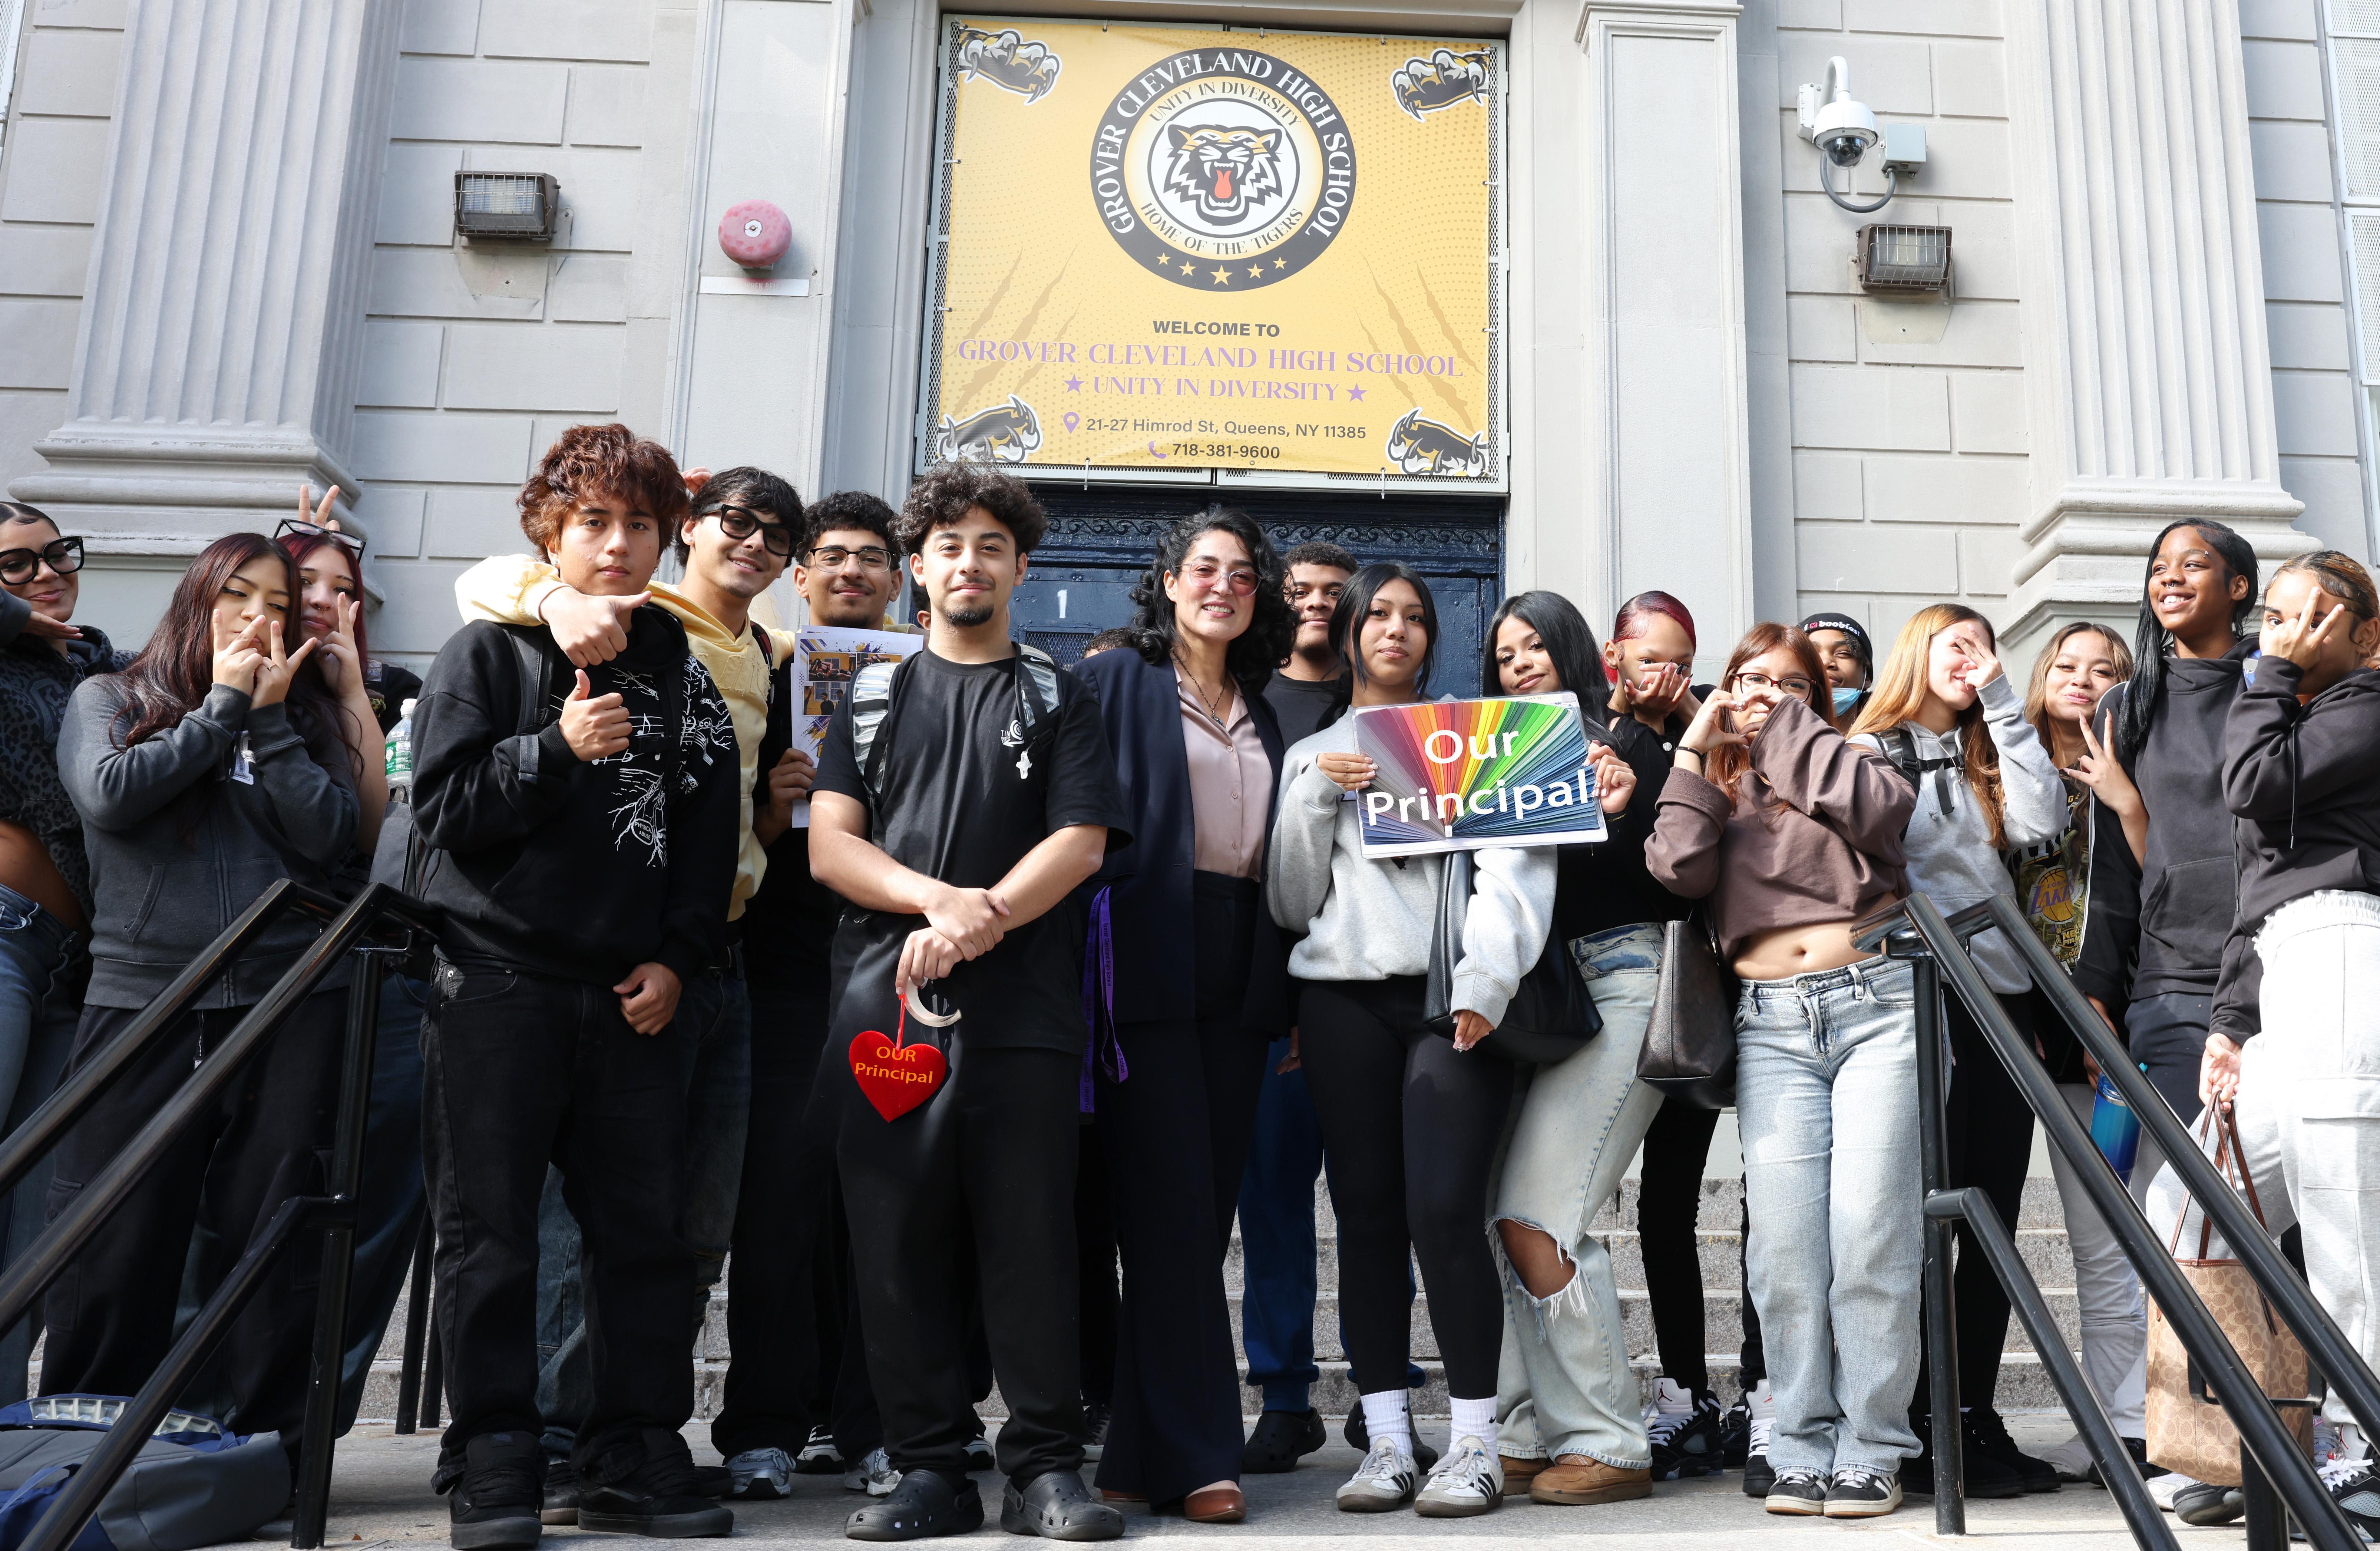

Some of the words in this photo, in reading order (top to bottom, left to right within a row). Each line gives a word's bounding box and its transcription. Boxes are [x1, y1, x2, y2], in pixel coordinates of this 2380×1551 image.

[1117, 52, 1272, 118] CLEVELAND
[1276, 70, 1337, 128] HIGH
[1149, 87, 1192, 121] UNITY
[1198, 82, 1216, 96] IN
[1222, 81, 1302, 127] DIVERSITY
[1096, 124, 1135, 234] GROVER
[1305, 132, 1351, 238] SCHOOL
[1141, 202, 1182, 242] HOME
[1184, 236, 1207, 252] OF
[1213, 241, 1247, 255] THE
[1250, 208, 1304, 249] TIGERS
[1153, 320, 1250, 336] WELCOME
[1255, 324, 1280, 337] TO
[958, 339, 1076, 363] GROVER
[1088, 343, 1257, 368] CLEVELAND
[1268, 349, 1335, 371] HIGH
[1346, 352, 1464, 377] SCHOOL
[1094, 376, 1167, 395] UNITY
[1176, 378, 1200, 397] IN
[1209, 379, 1339, 402] DIVERSITY
[1086, 418, 1128, 431] 21-27
[1134, 419, 1193, 433] Himrod
[1198, 420, 1219, 435] St,
[1224, 421, 1290, 437] Queens,
[1296, 424, 1319, 437] NY
[1323, 425, 1366, 439] 11385
[1172, 443, 1280, 459] 718-381-9600
[1057, 589, 1068, 618] 1
[1819, 620, 1860, 636] boobies!
[1424, 729, 1519, 764] Our
[1366, 769, 1588, 826] Principal
[634, 821, 652, 834] PHYSICAL
[639, 831, 651, 840] ABUSE
[876, 1046, 916, 1062] OUR
[855, 1062, 933, 1084] Principal
